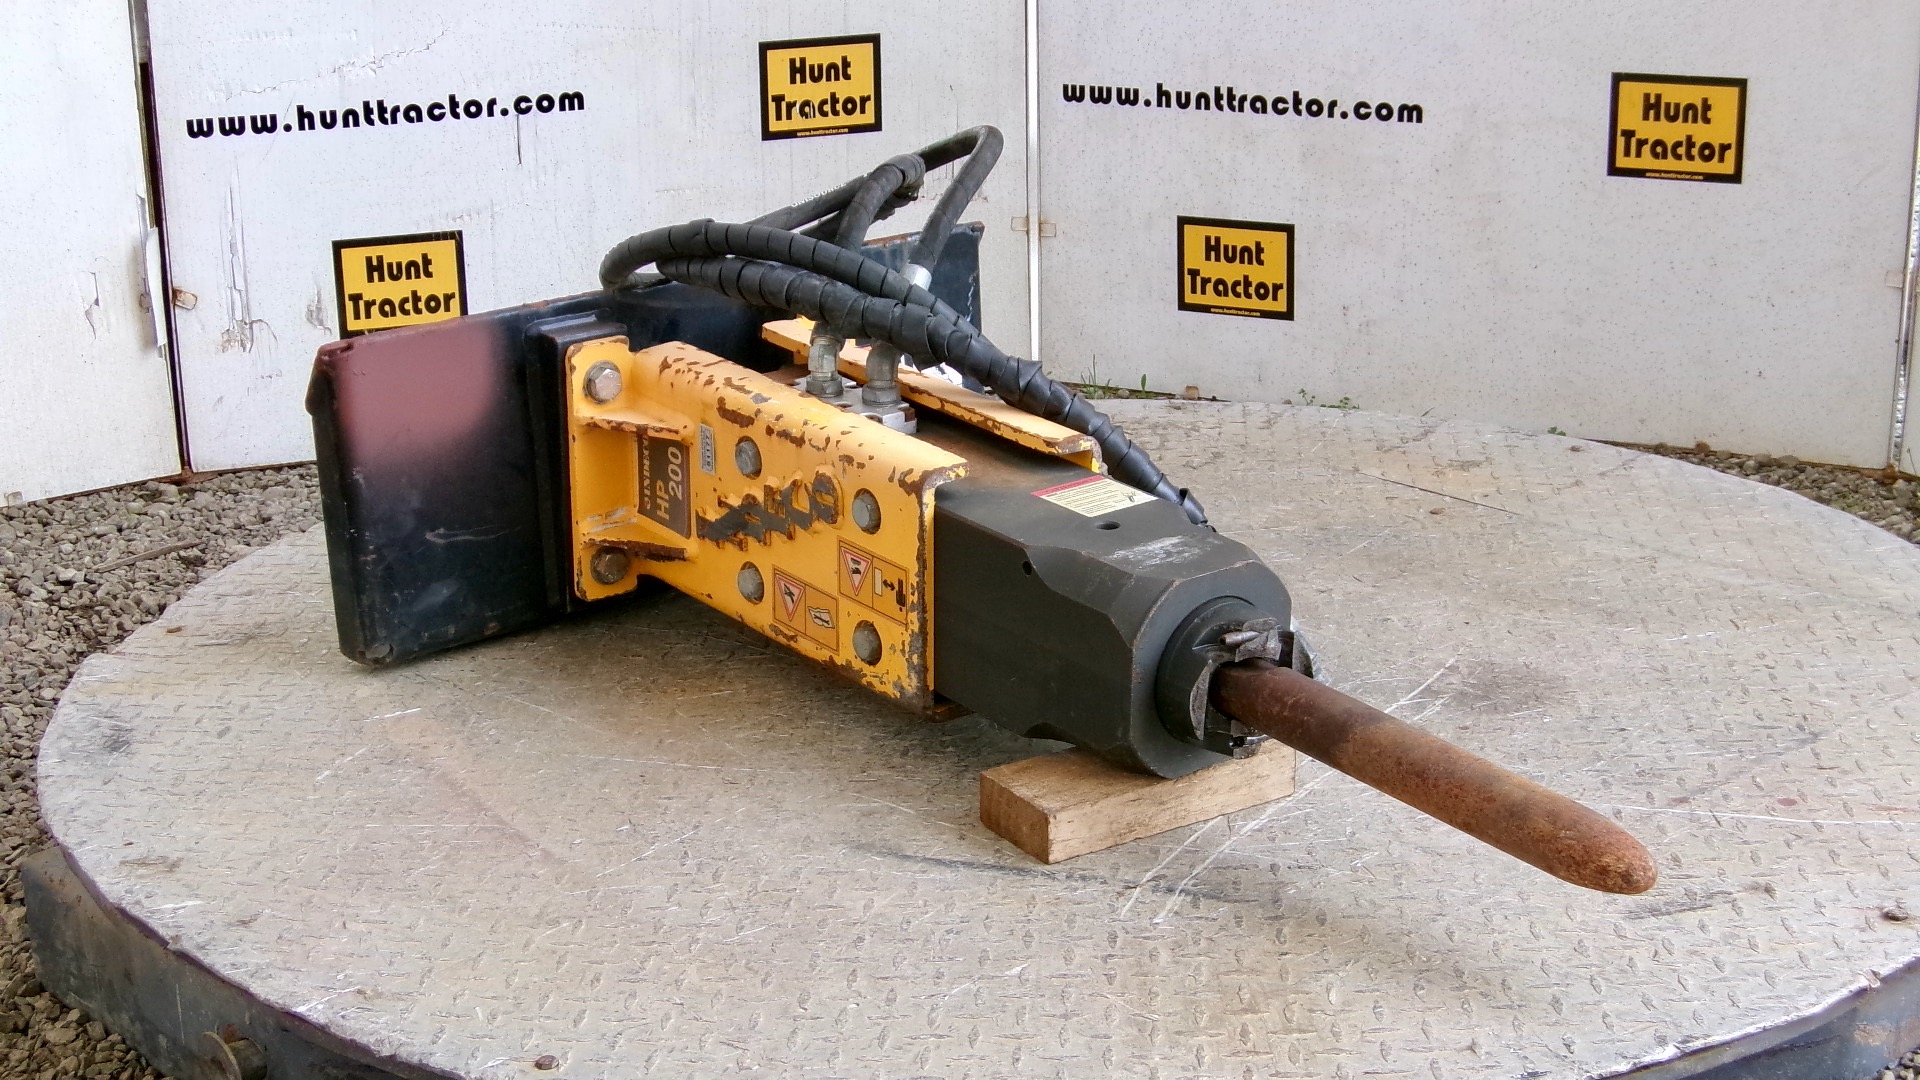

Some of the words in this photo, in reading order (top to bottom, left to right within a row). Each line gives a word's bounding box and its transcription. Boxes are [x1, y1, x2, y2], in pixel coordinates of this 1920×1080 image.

[788, 55, 852, 85] Hunt
[185, 90, 586, 139] www.hunttractor.com
[770, 91, 872, 121] Tractor
[1062, 82, 1424, 124] www.hunttractor.com
[1642, 92, 1712, 125] Hunt
[1620, 128, 1732, 164] Tractor
[1204, 234, 1265, 267] Hunt
[364, 252, 434, 284] Hunt
[1186, 267, 1284, 302] Tractor
[347, 289, 456, 321] Tractor
[667, 446, 683, 501] 200
[656, 479, 670, 521] HP
